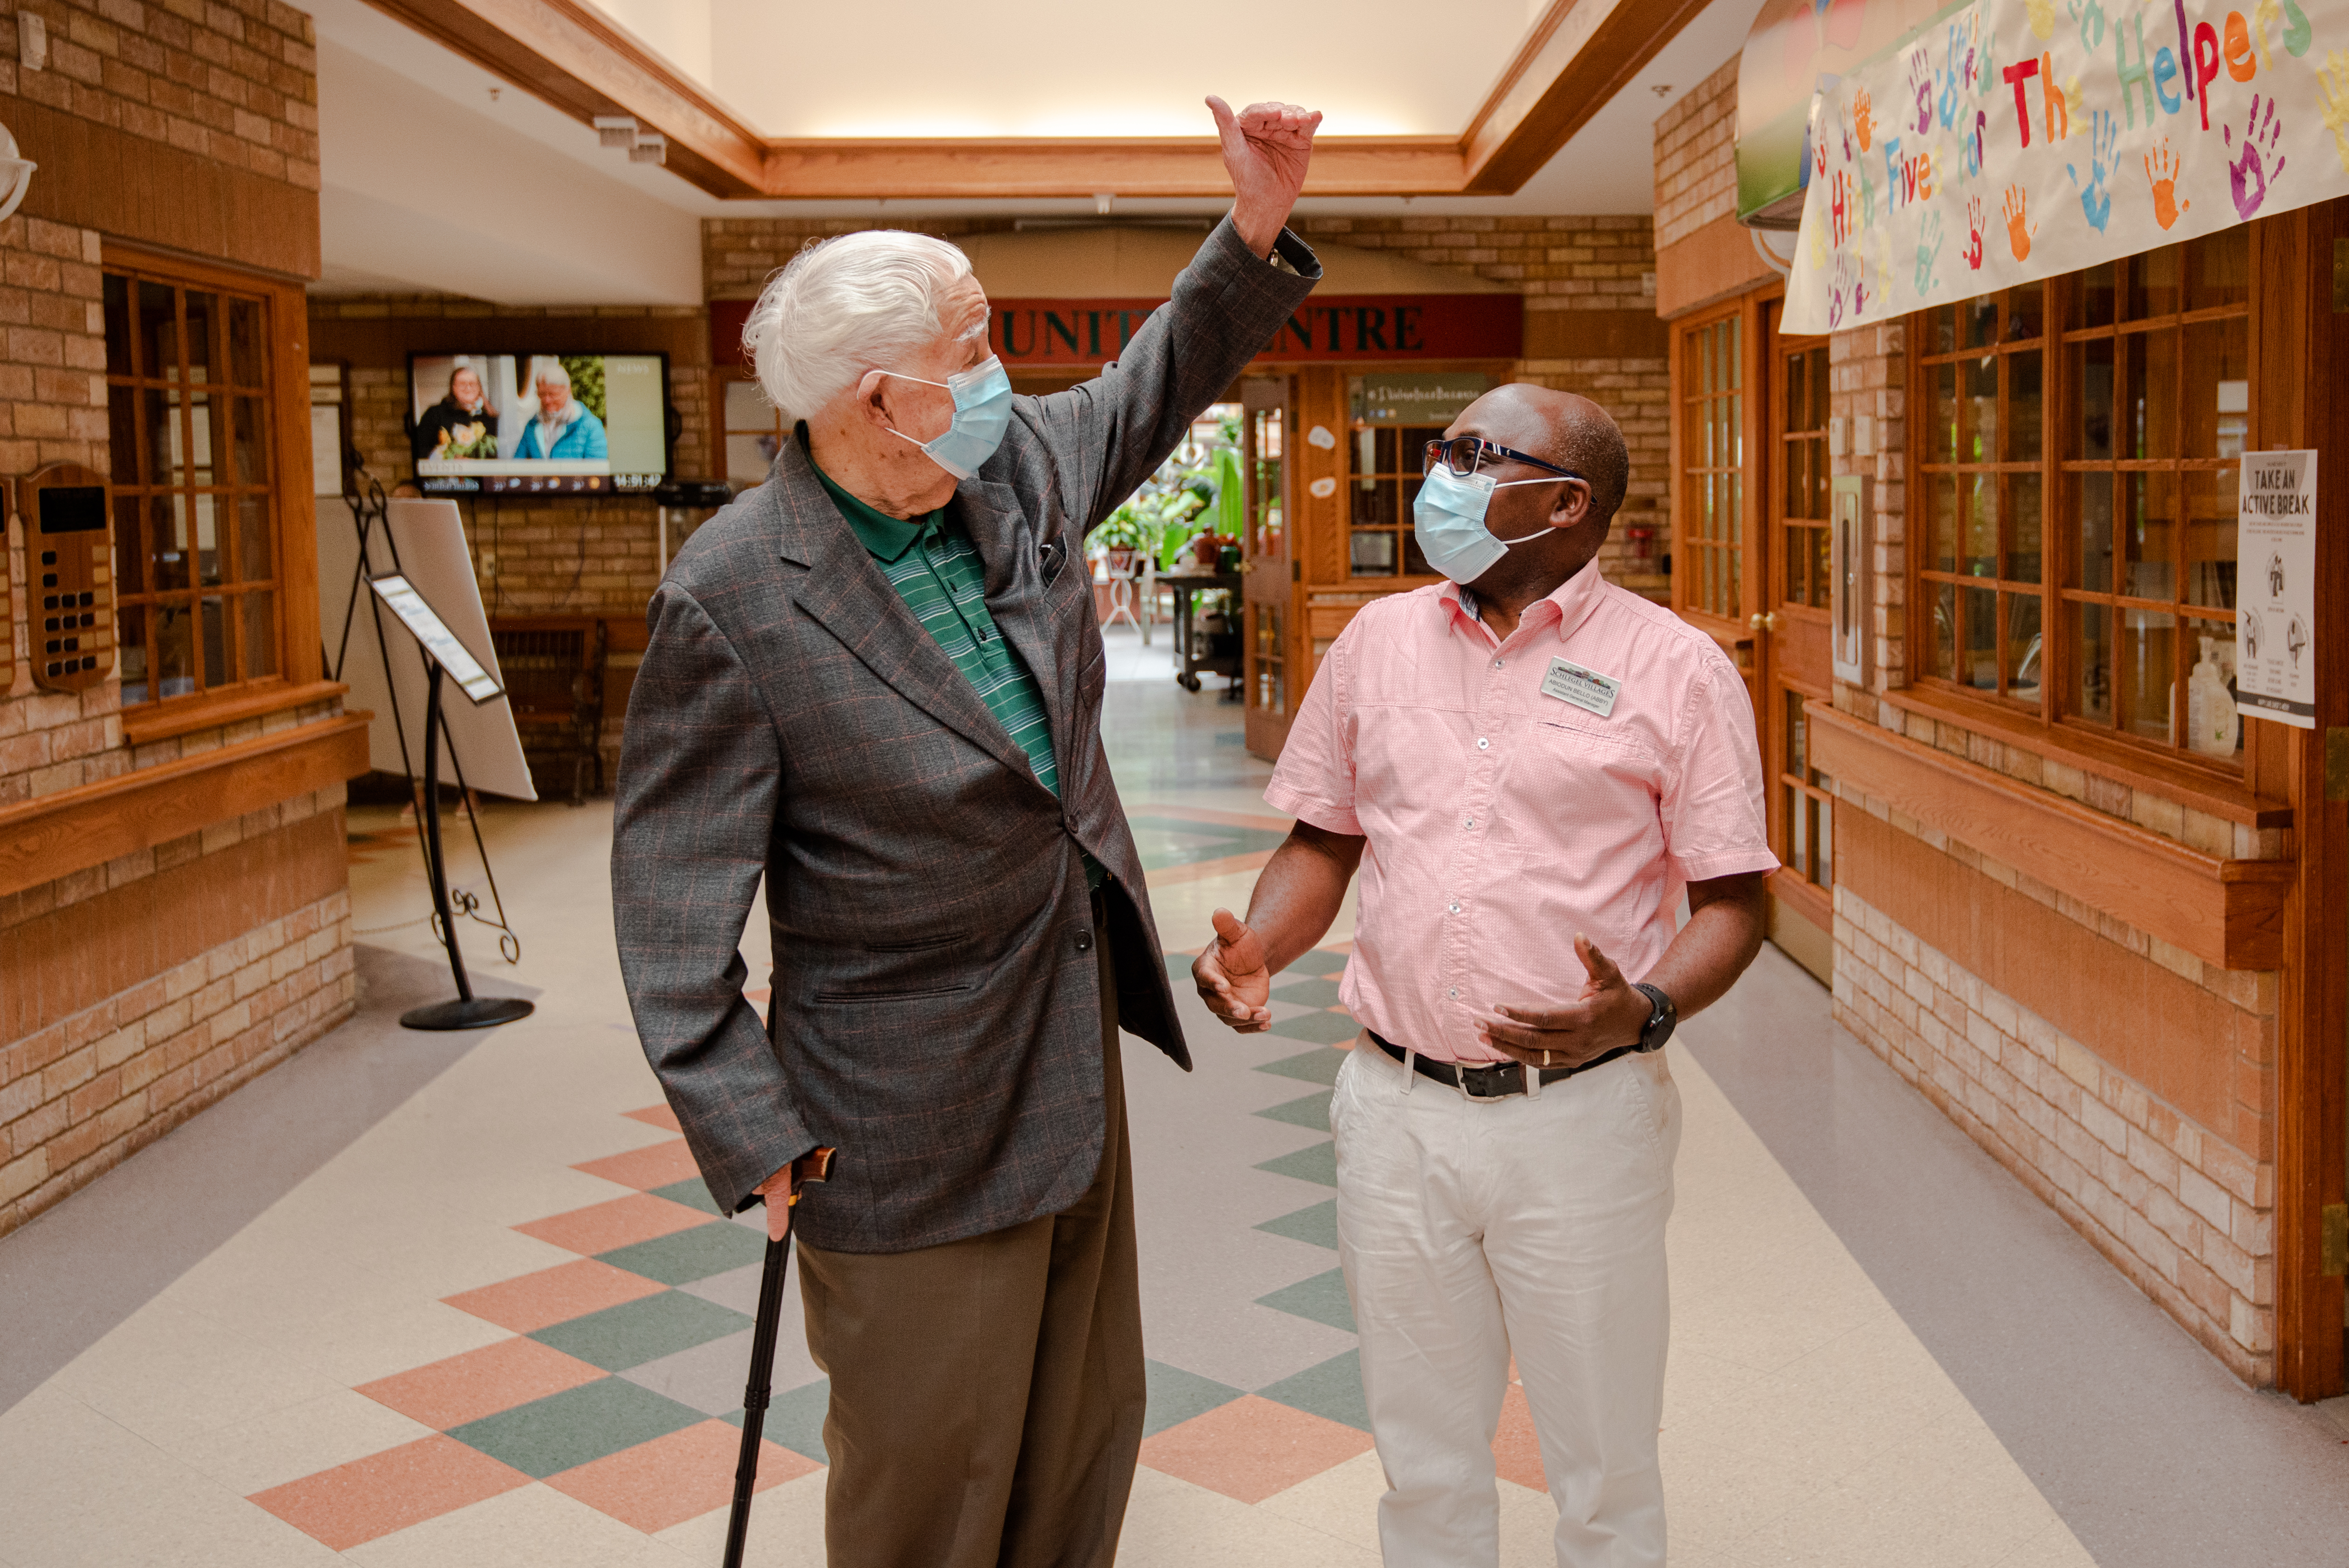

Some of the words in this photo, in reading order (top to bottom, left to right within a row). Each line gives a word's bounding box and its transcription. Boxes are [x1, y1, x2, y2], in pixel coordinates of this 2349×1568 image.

[1832, 149, 1875, 261] High
[1885, 136, 1944, 215] Fives
[1958, 103, 1986, 187] For
[2003, 51, 2089, 148] The
[2115, 0, 2312, 131] Helpers
[1260, 306, 1424, 353] NTRE
[2255, 469, 2281, 489] TAKE
[2282, 469, 2295, 489] AN
[2242, 494, 2275, 514] ACTIVE
[2277, 494, 2309, 515] BREAK
[1548, 679, 1573, 692] ABIODUN
[1573, 687, 1590, 698] BELLO
[1591, 695, 1608, 706] (ABBY)
[1550, 667, 1582, 686] SCHLEGEL
[1584, 682, 1615, 698] VILLAGES
[1552, 688, 1569, 697] Assistant
[1569, 694, 1584, 702] General
[1584, 700, 1599, 709] Manager
